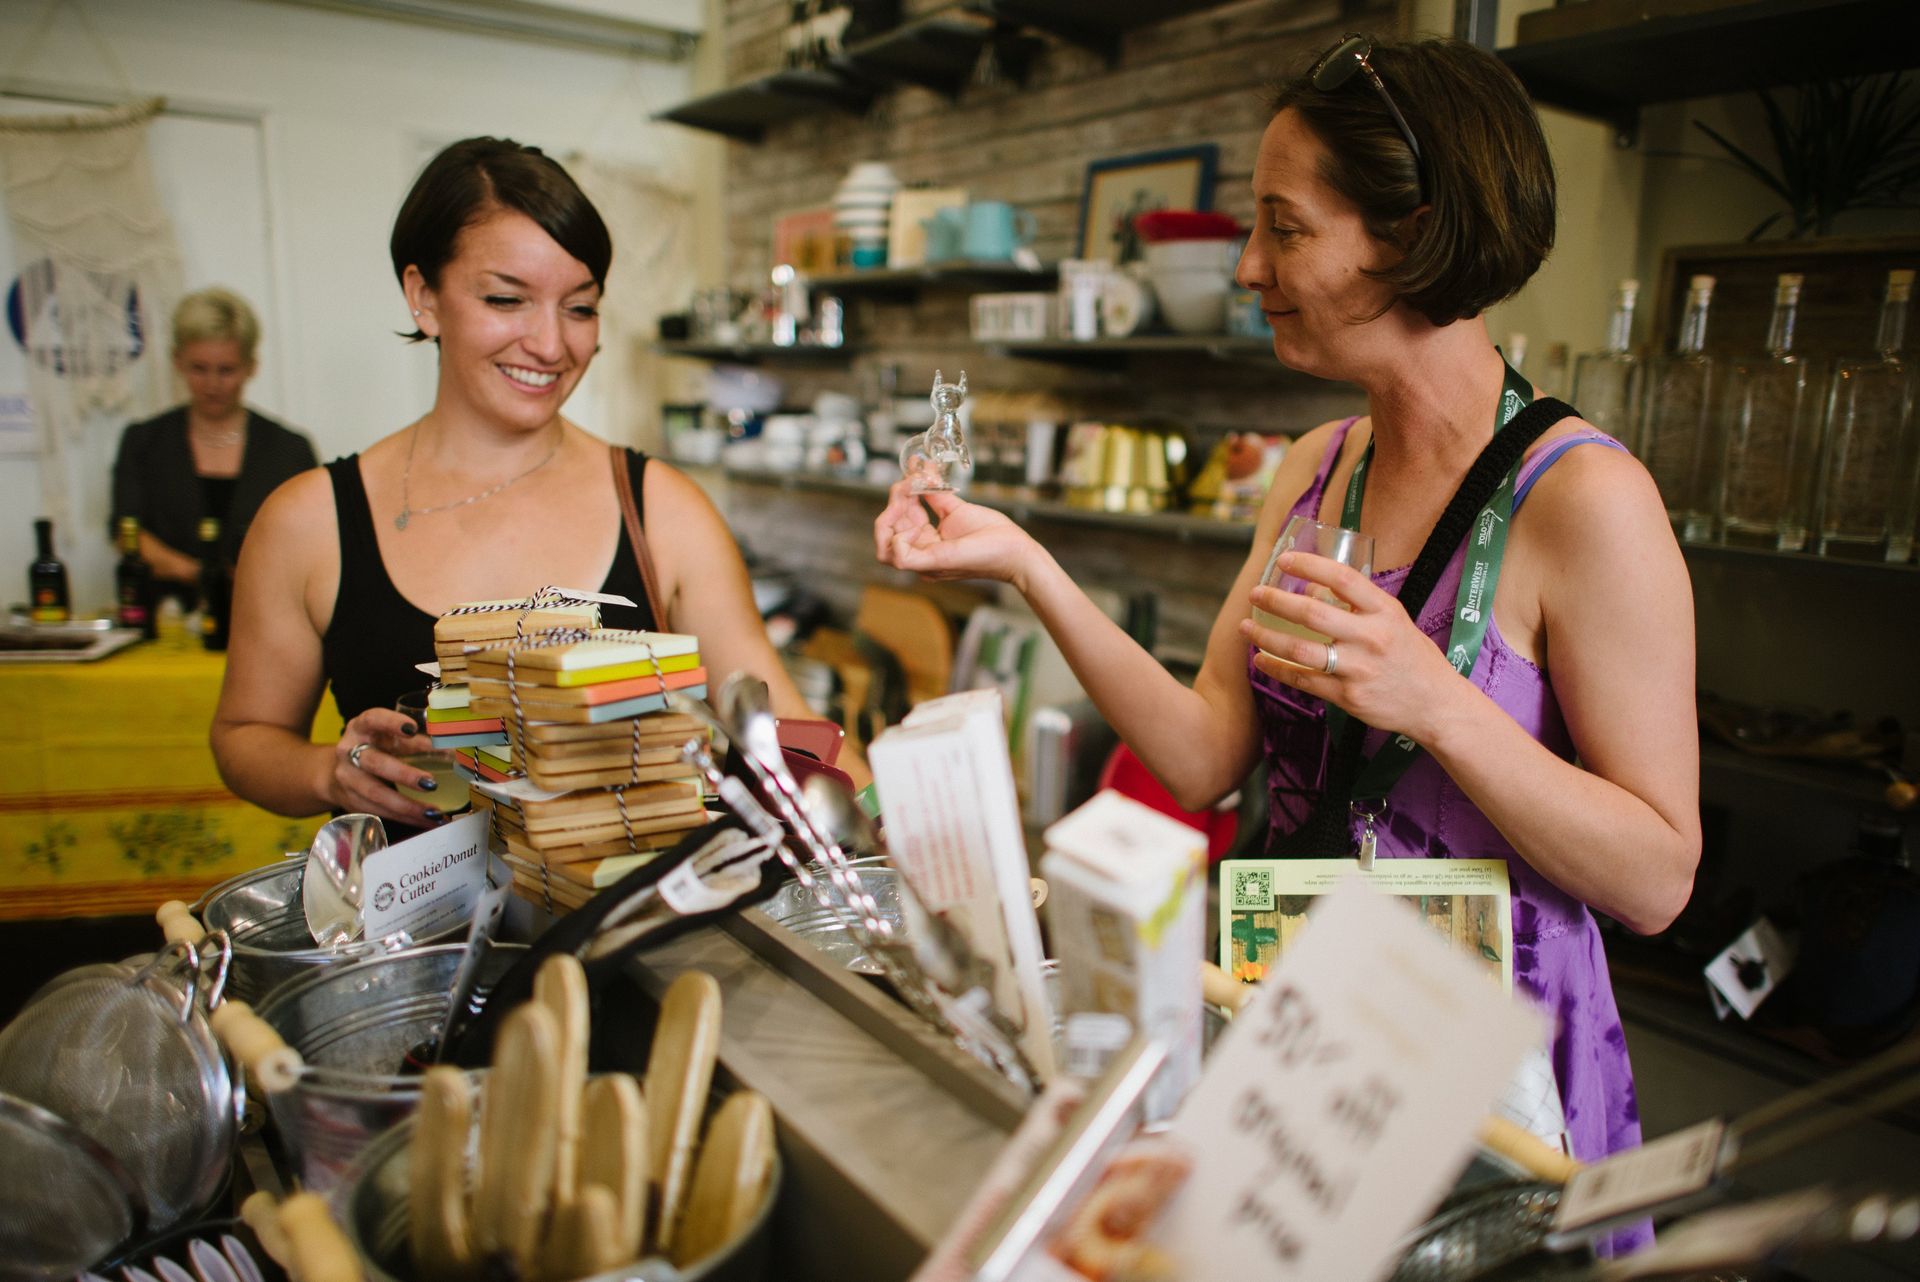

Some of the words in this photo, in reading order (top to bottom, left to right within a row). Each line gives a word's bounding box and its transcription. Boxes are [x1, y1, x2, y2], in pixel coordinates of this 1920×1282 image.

[1478, 526, 1488, 545] YOLO
[399, 843, 478, 889] Cookie/Donut
[400, 880, 436, 905] Cutter
